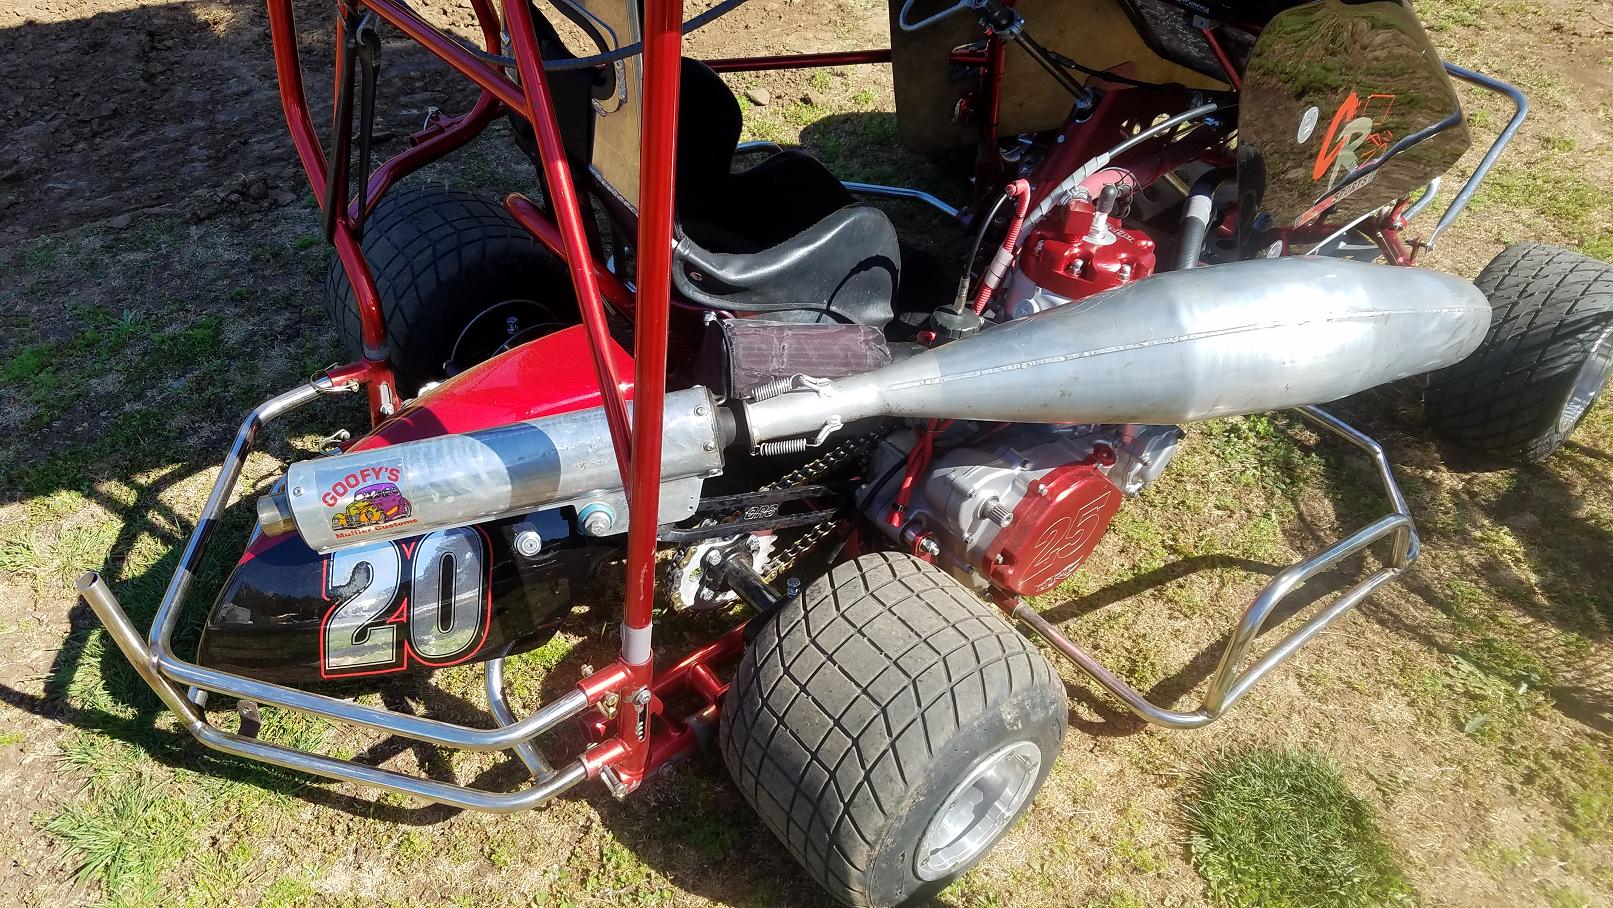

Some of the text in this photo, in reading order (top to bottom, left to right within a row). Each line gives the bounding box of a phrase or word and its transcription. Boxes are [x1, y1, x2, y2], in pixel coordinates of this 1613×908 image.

[322, 466, 401, 508] GOOFY'S
[374, 518, 418, 532] Customs
[1018, 490, 1111, 587] 25
[320, 525, 493, 678] 20
